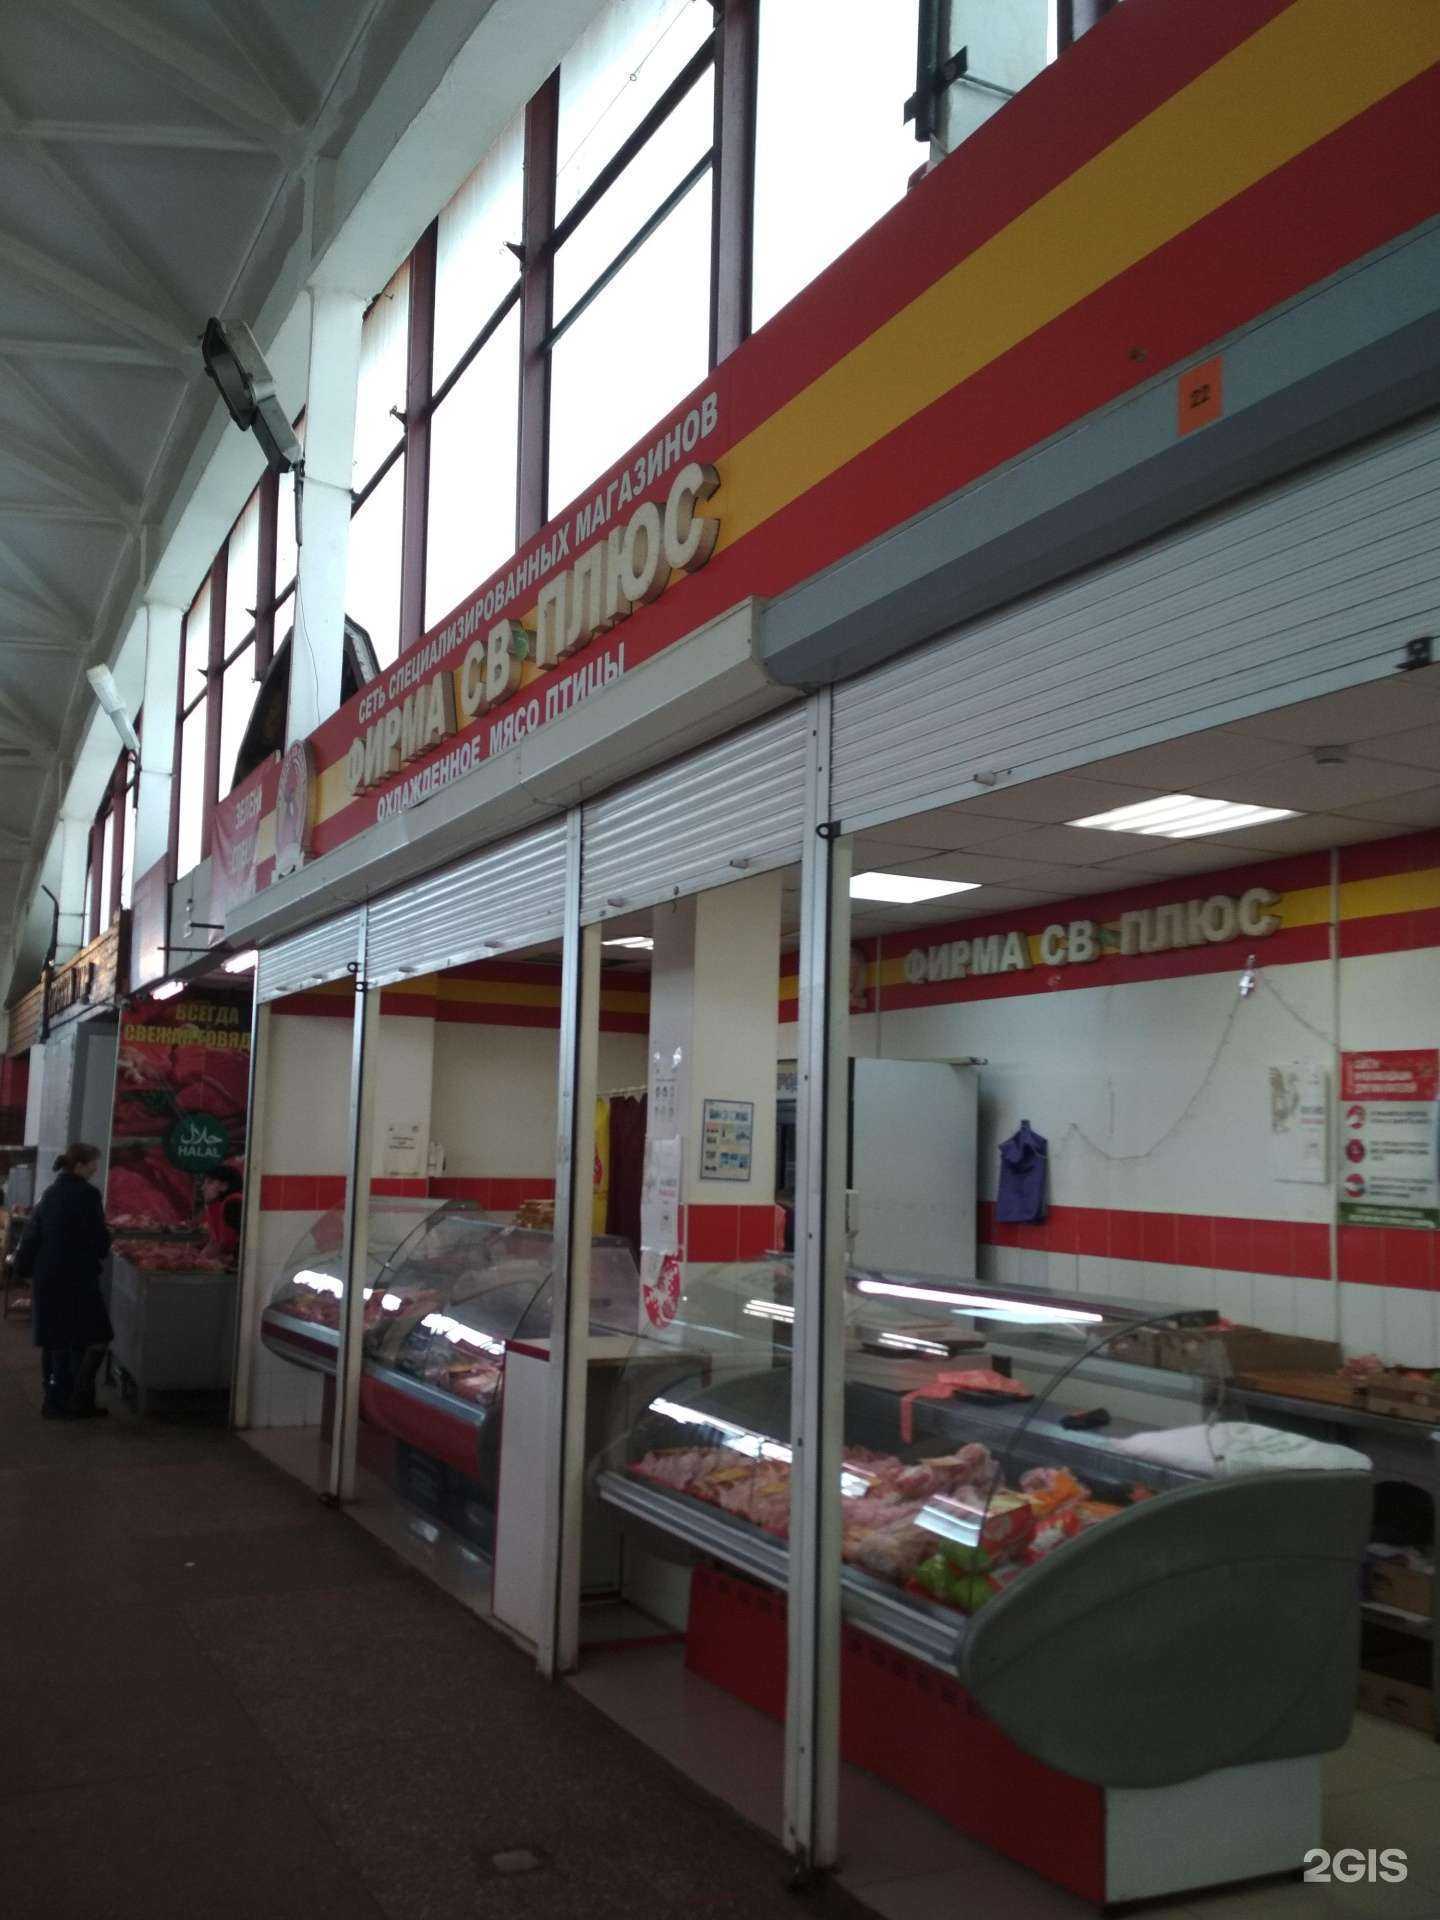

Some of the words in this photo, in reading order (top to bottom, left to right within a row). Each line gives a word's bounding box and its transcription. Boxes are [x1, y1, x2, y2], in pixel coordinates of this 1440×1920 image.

[358, 686, 385, 724] СЕТЬ
[388, 521, 571, 700] СПЕЦИАЛИЗИРОВАННЫХ
[575, 391, 719, 547] МАГАЗИНОВ
[345, 671, 454, 795] ФИРМА
[460, 618, 521, 717] СВ
[537, 462, 717, 669] ПЛЮС
[376, 735, 482, 822] ОХЛАЖДЕННОЕ
[489, 698, 541, 758] МЯСО
[545, 642, 626, 722] ПТИЦЫ
[904, 931, 1027, 984] ФИРМА
[1041, 919, 1098, 966] СВ
[1120, 887, 1281, 956] ПЛЮС
[175, 1003, 240, 1025] ВСЕГДА
[178, 1145, 221, 1158] HALAL
